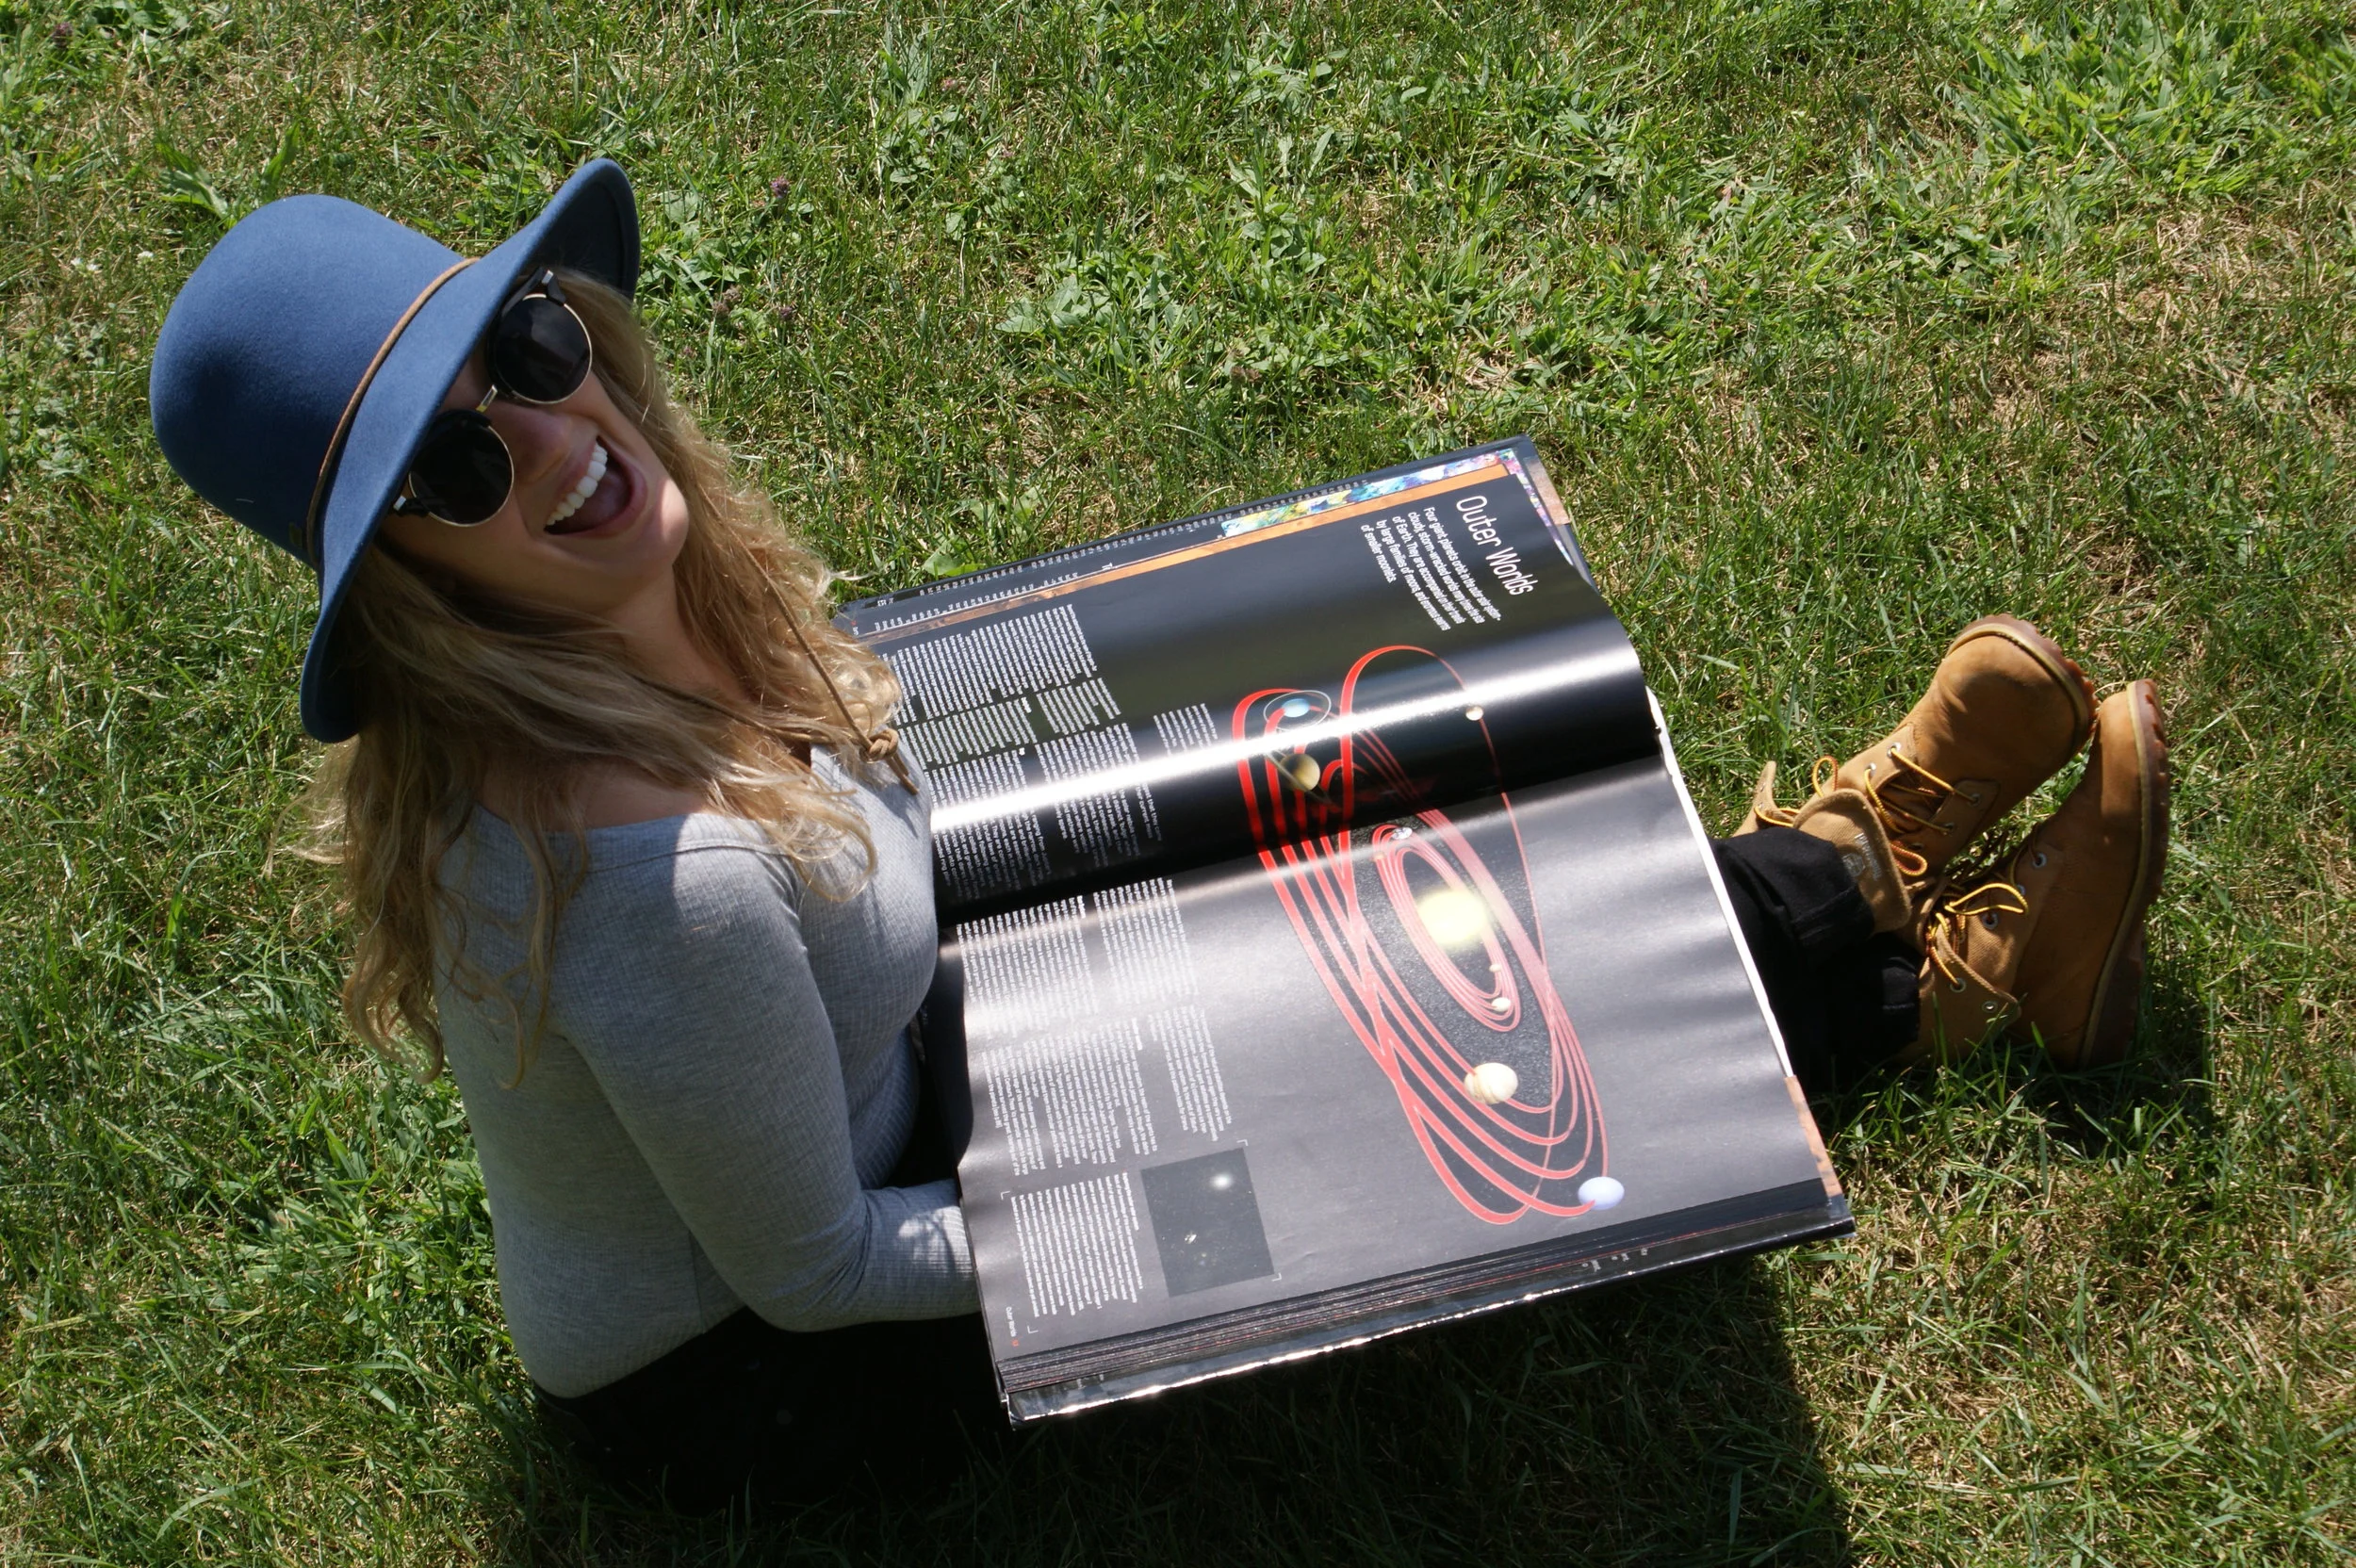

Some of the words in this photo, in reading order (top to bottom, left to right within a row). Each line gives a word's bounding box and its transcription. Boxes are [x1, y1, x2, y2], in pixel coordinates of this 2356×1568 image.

[1423, 507, 1438, 522] Four
[1376, 519, 1387, 529] by
[1429, 522, 1448, 539] giant
[1381, 528, 1396, 545] large
[1396, 523, 1414, 544] Earth.
[1406, 541, 1420, 558] They
[1408, 512, 1426, 534] cloudy,
[1418, 531, 1452, 577] storm-wracked
[1442, 575, 1460, 592] worlds
[1437, 538, 1459, 562] planets
[1456, 496, 1501, 547] Outer
[1485, 547, 1538, 596] Worlds
[1365, 532, 1383, 554] smaller
[1376, 554, 1397, 583] moonlets.
[1388, 544, 1407, 568] families
[1414, 557, 1426, 568] are
[1452, 560, 1468, 575] orbit
[1405, 573, 1421, 594] moons,
[1418, 567, 1448, 599] accompanied
[1463, 578, 1476, 588] the
[1415, 591, 1430, 602] and
[1468, 586, 1483, 598] outer
[1420, 599, 1440, 618] enormous
